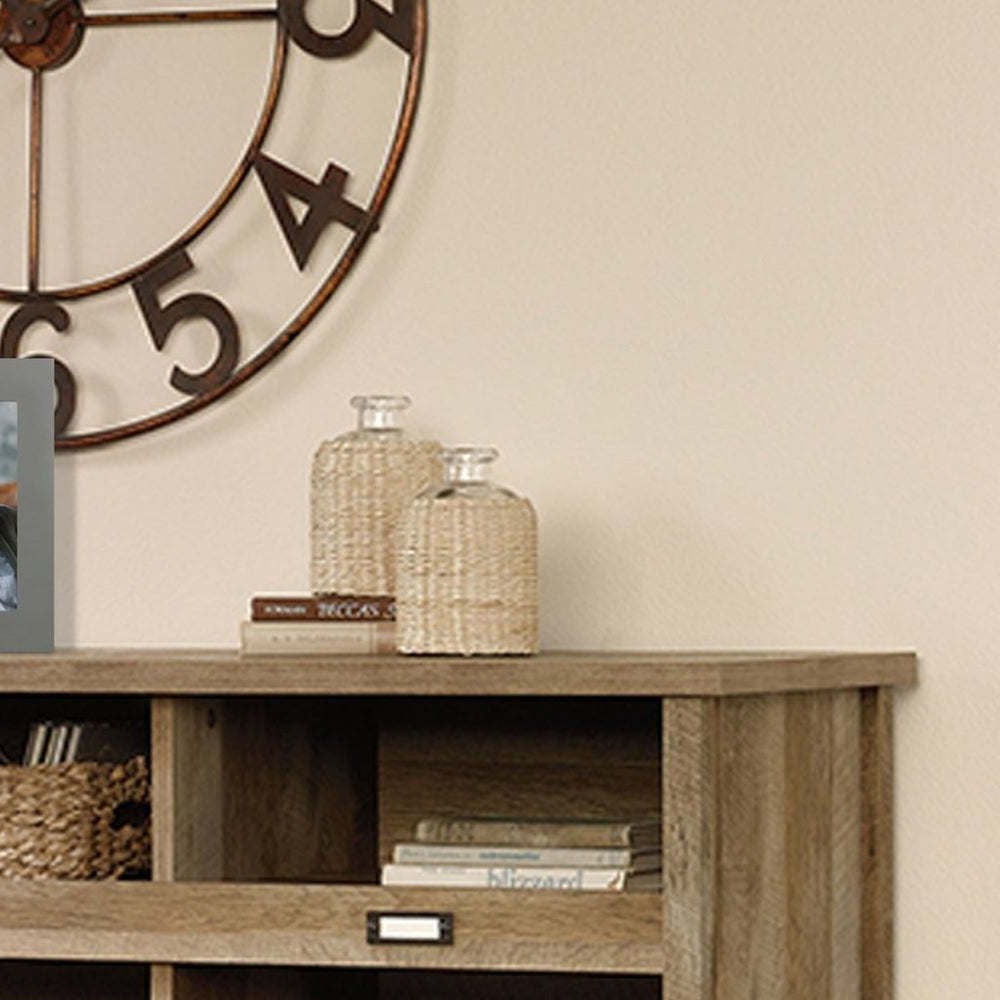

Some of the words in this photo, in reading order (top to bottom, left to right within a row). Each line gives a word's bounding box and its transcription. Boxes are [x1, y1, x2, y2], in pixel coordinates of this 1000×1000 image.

[250, 148, 380, 272] 4
[130, 246, 240, 397] 5
[487, 867, 583, 890] blizzard
